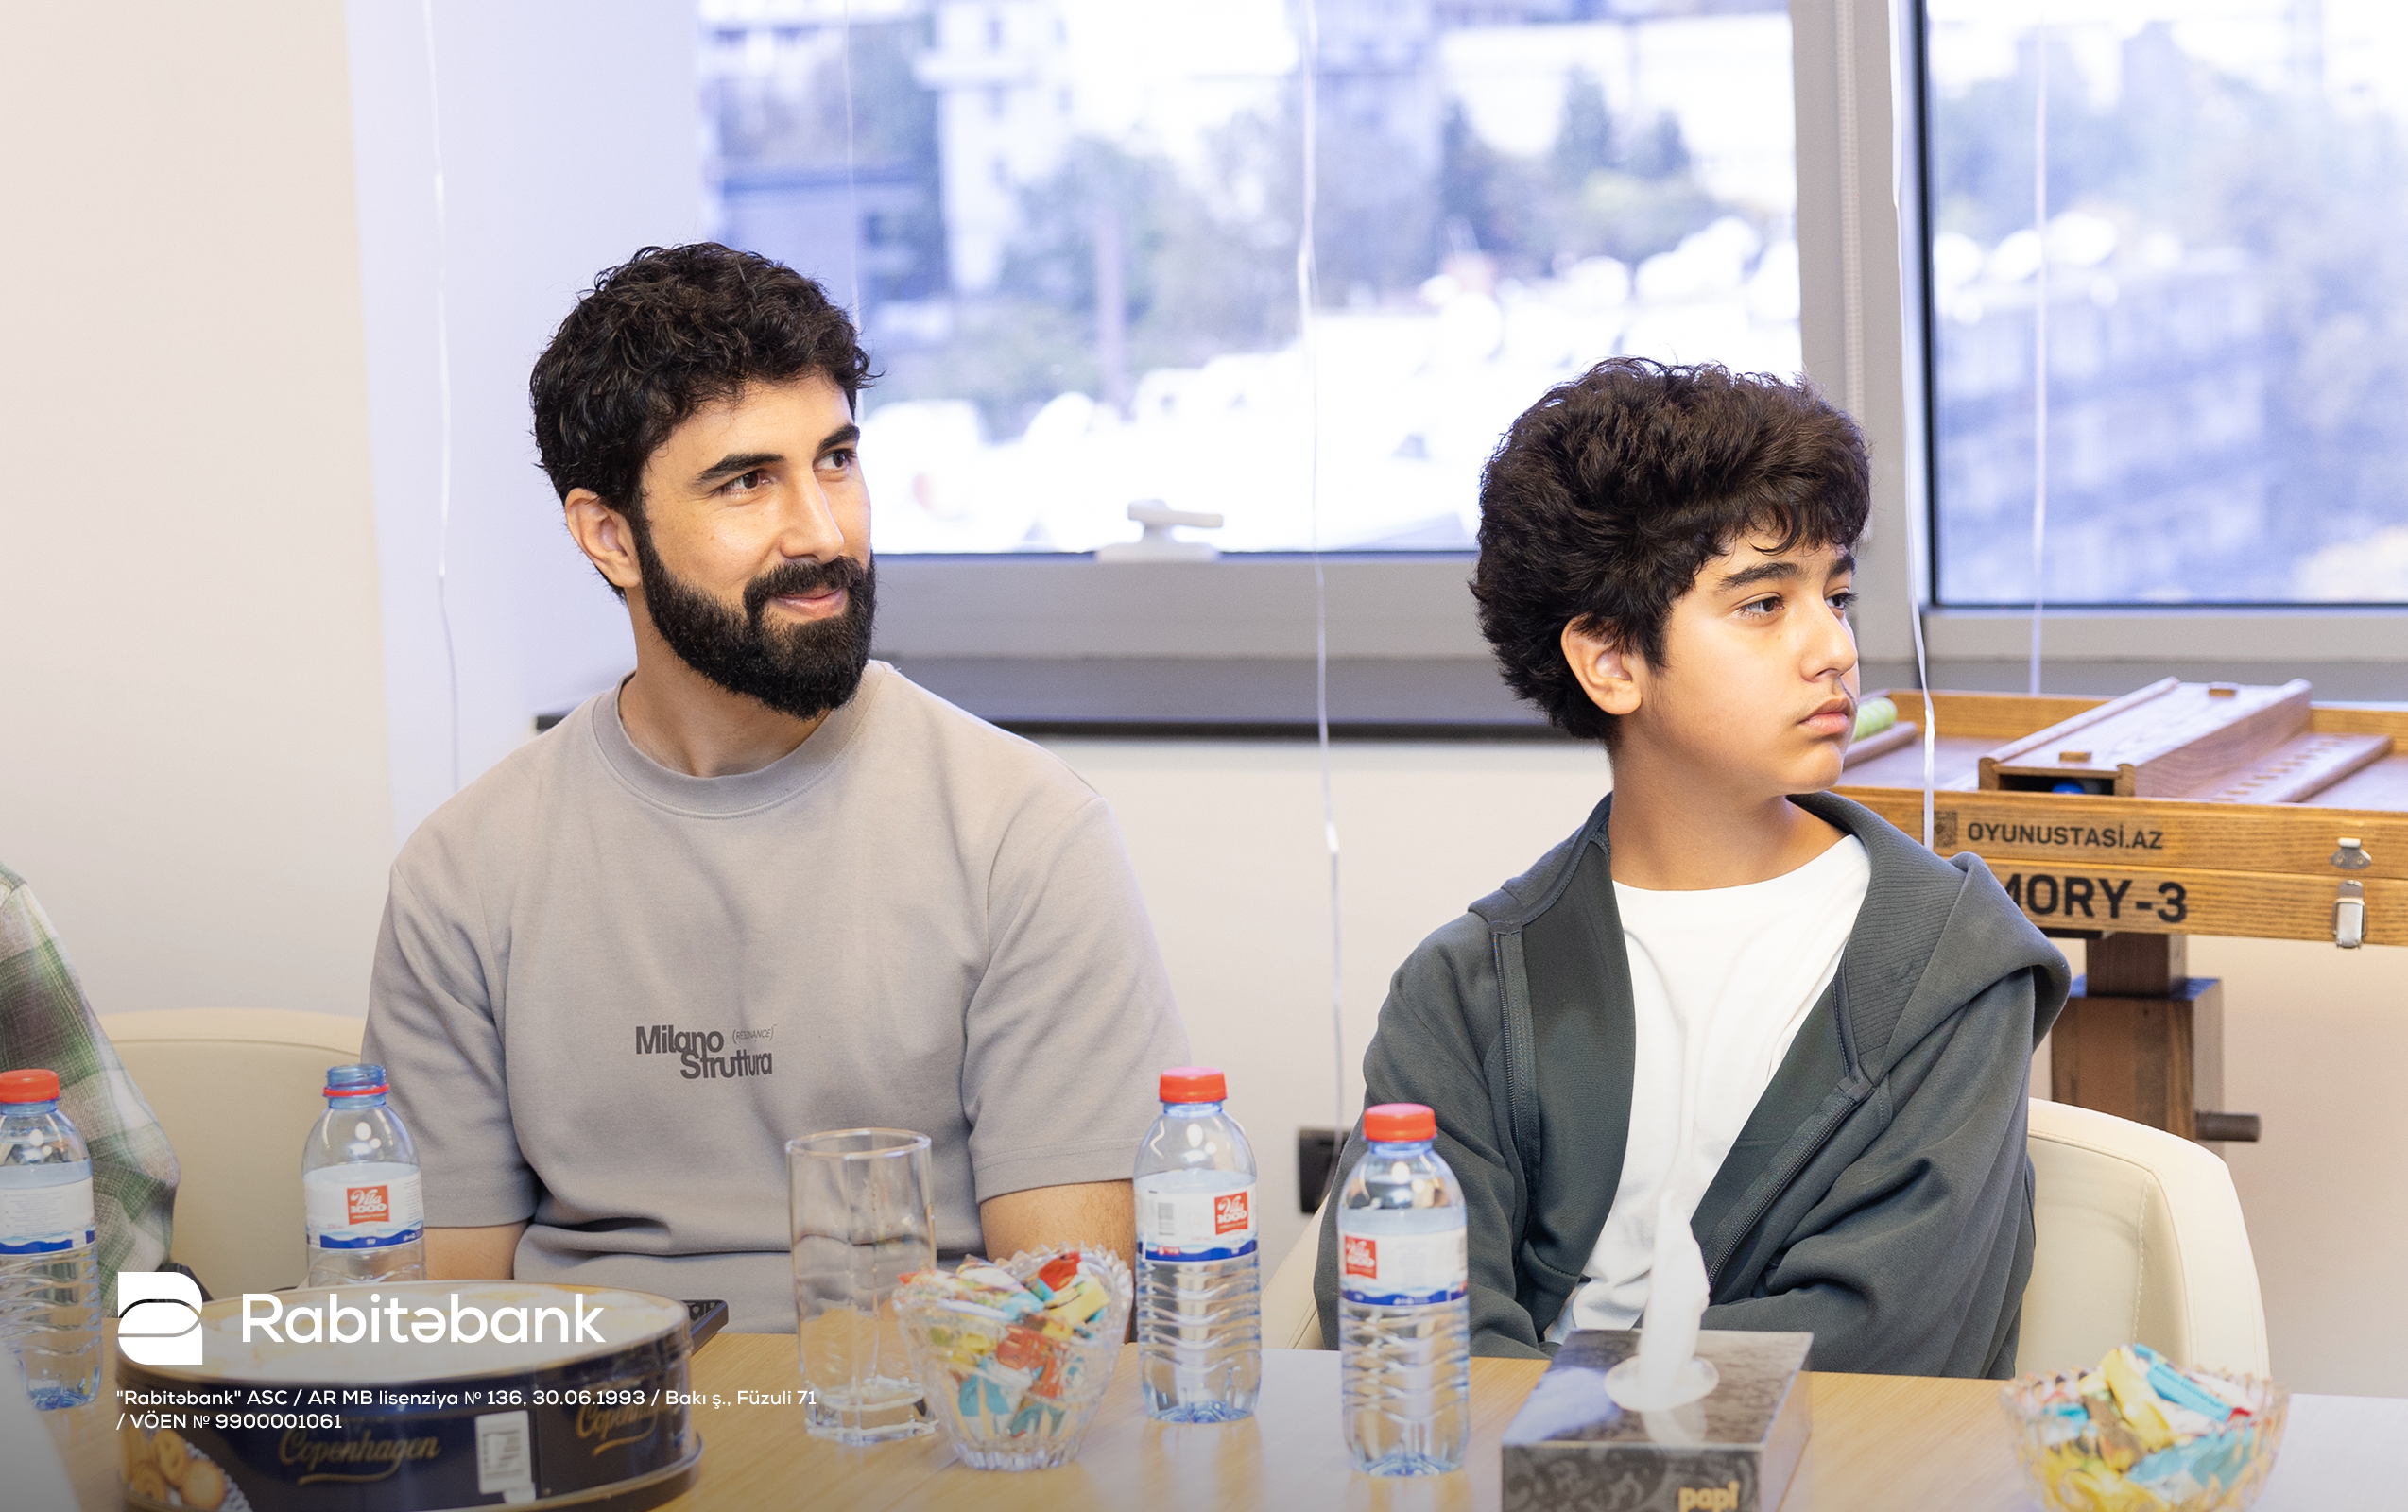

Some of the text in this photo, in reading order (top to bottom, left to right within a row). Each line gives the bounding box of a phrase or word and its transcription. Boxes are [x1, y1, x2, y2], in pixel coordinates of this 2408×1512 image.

[1969, 823, 2163, 850] OYUNUSTASİ.AZ
[636, 1024, 724, 1054] Milano
[680, 1049, 773, 1079] Struttura
[279, 1427, 441, 1480] Copenhagen
[1678, 1481, 1739, 1512] papi
